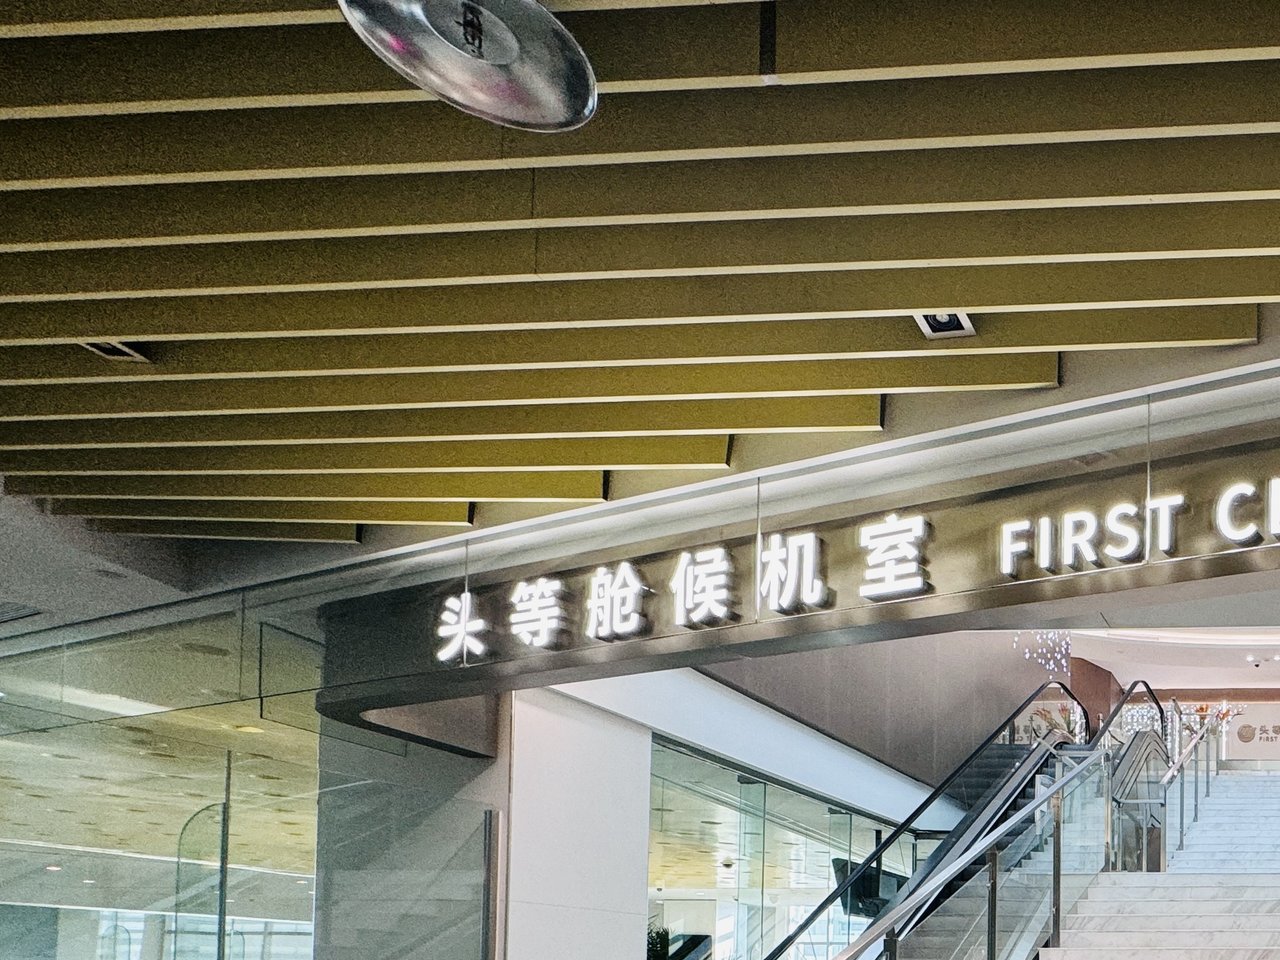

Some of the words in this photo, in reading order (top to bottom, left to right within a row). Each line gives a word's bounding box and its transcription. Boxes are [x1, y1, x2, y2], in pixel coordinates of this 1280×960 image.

[436, 513, 927, 662] 头等舱候机室
[1000, 494, 1184, 575] FIRST
